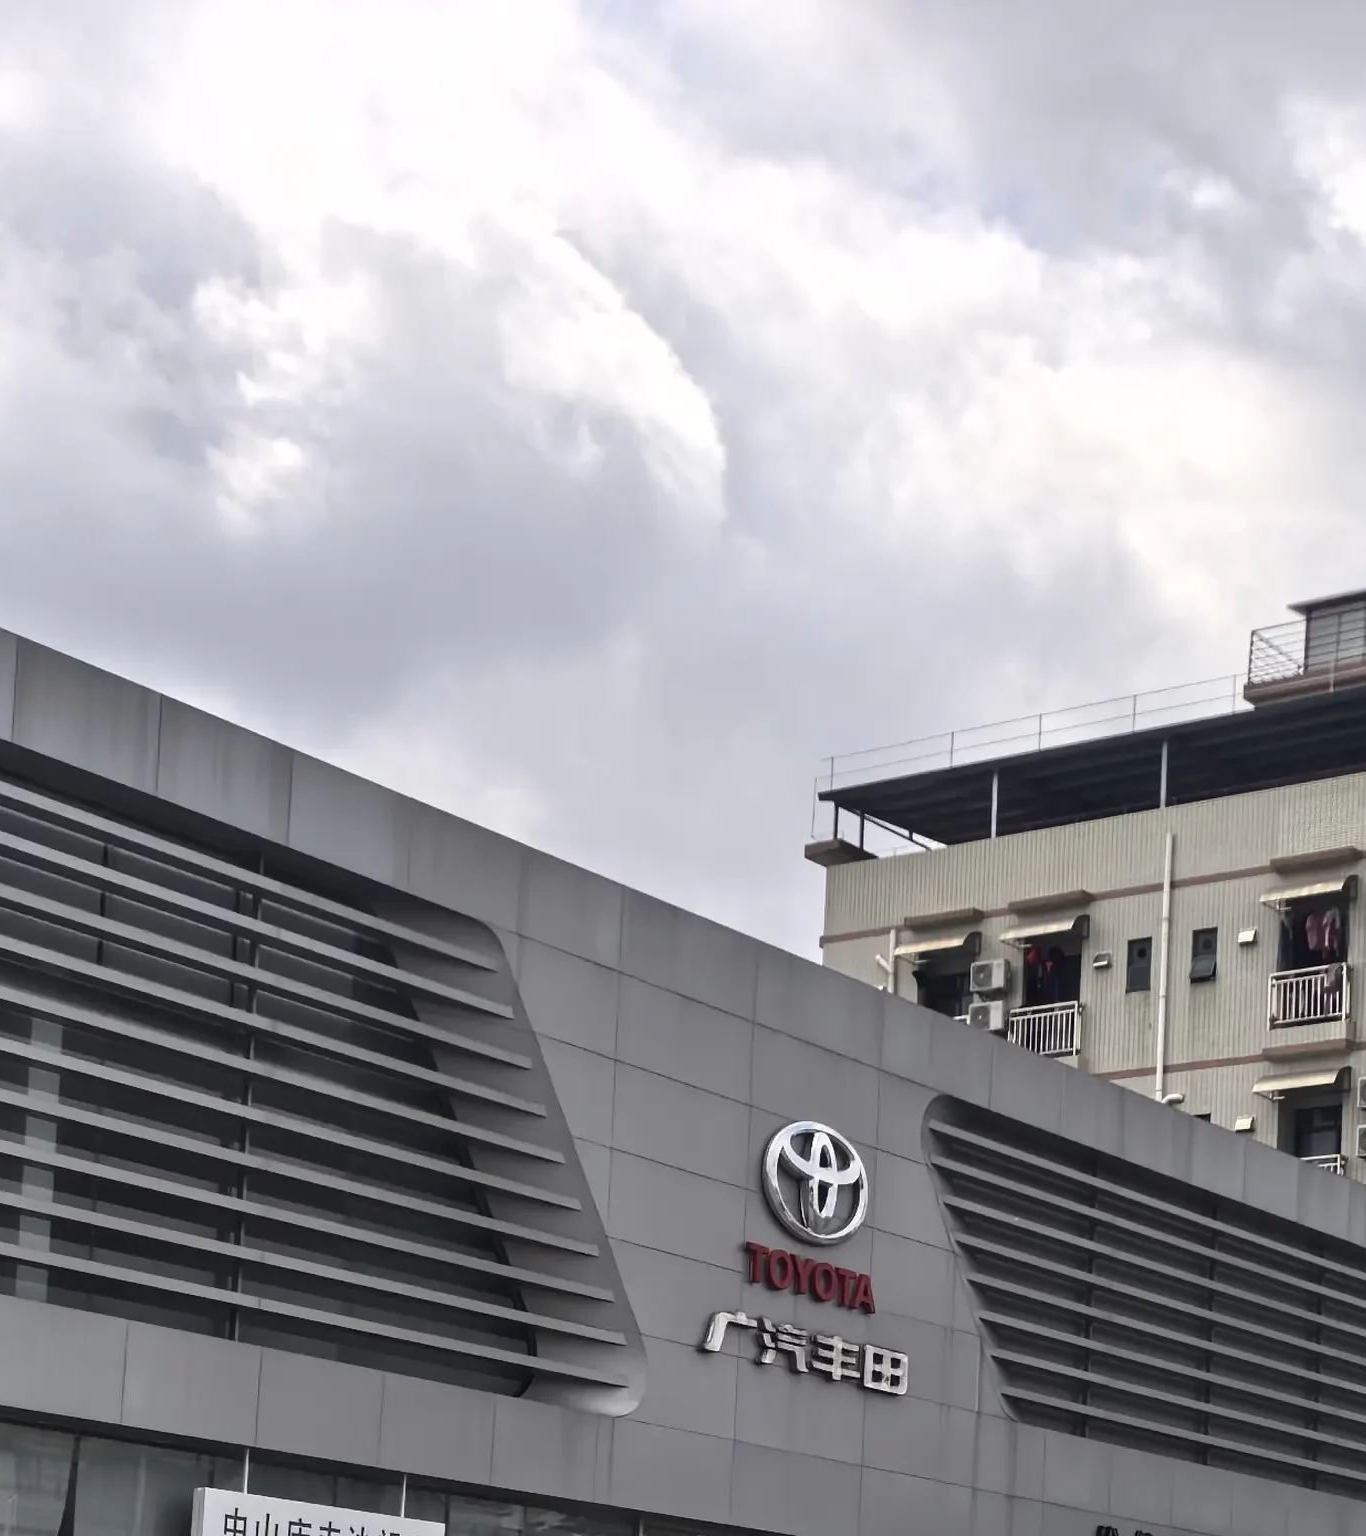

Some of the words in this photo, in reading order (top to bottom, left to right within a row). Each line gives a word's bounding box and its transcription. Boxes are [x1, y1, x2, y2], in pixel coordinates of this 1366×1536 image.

[746, 1241, 876, 1314] TOYOTA
[698, 1310, 909, 1395] 广汽丰田
